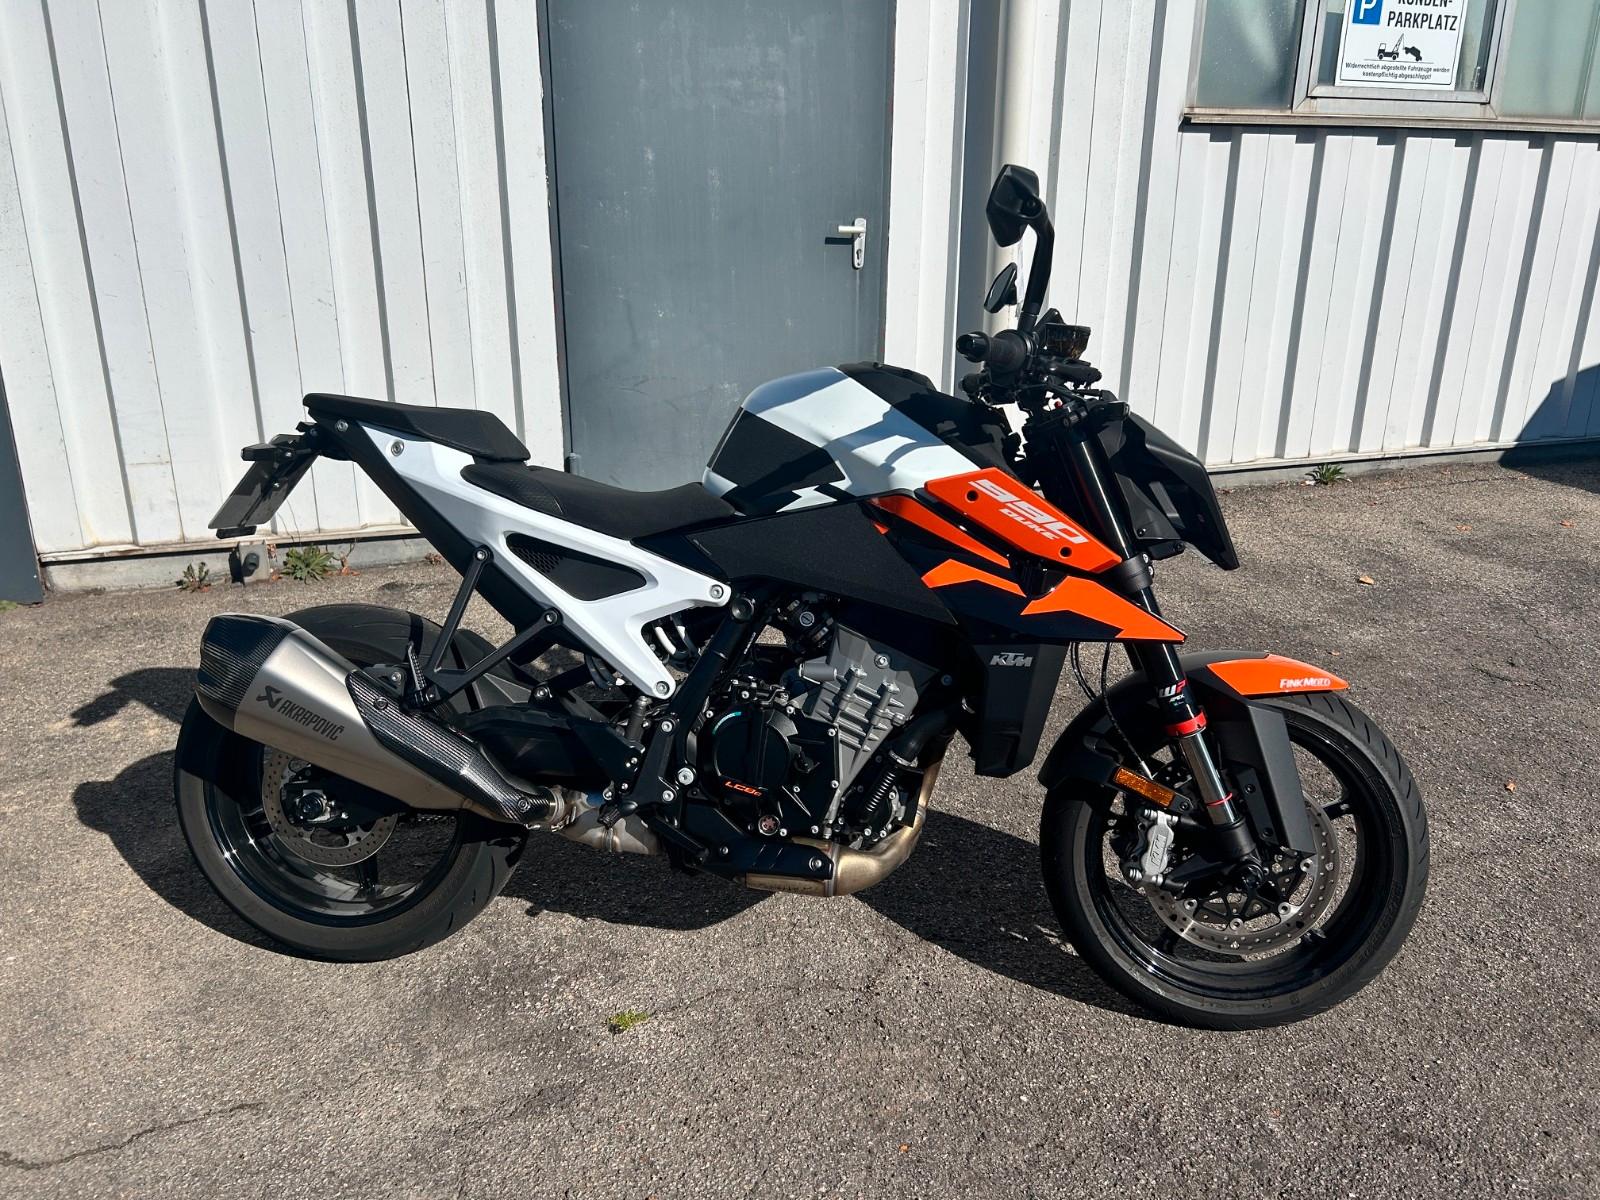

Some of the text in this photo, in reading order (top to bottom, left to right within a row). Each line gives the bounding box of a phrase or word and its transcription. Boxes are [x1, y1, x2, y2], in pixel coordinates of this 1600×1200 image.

[1387, 11, 1458, 31] PARKPLATZ
[1345, 62, 1381, 70] Widerrechtlich
[1381, 64, 1407, 72] abgestellte
[1408, 65, 1432, 73] Fahrzeuge
[1362, 71, 1398, 79] kostenpflichtig
[968, 479, 1089, 544] 990
[998, 508, 1061, 540] DUKE
[990, 652, 1033, 667] KTM
